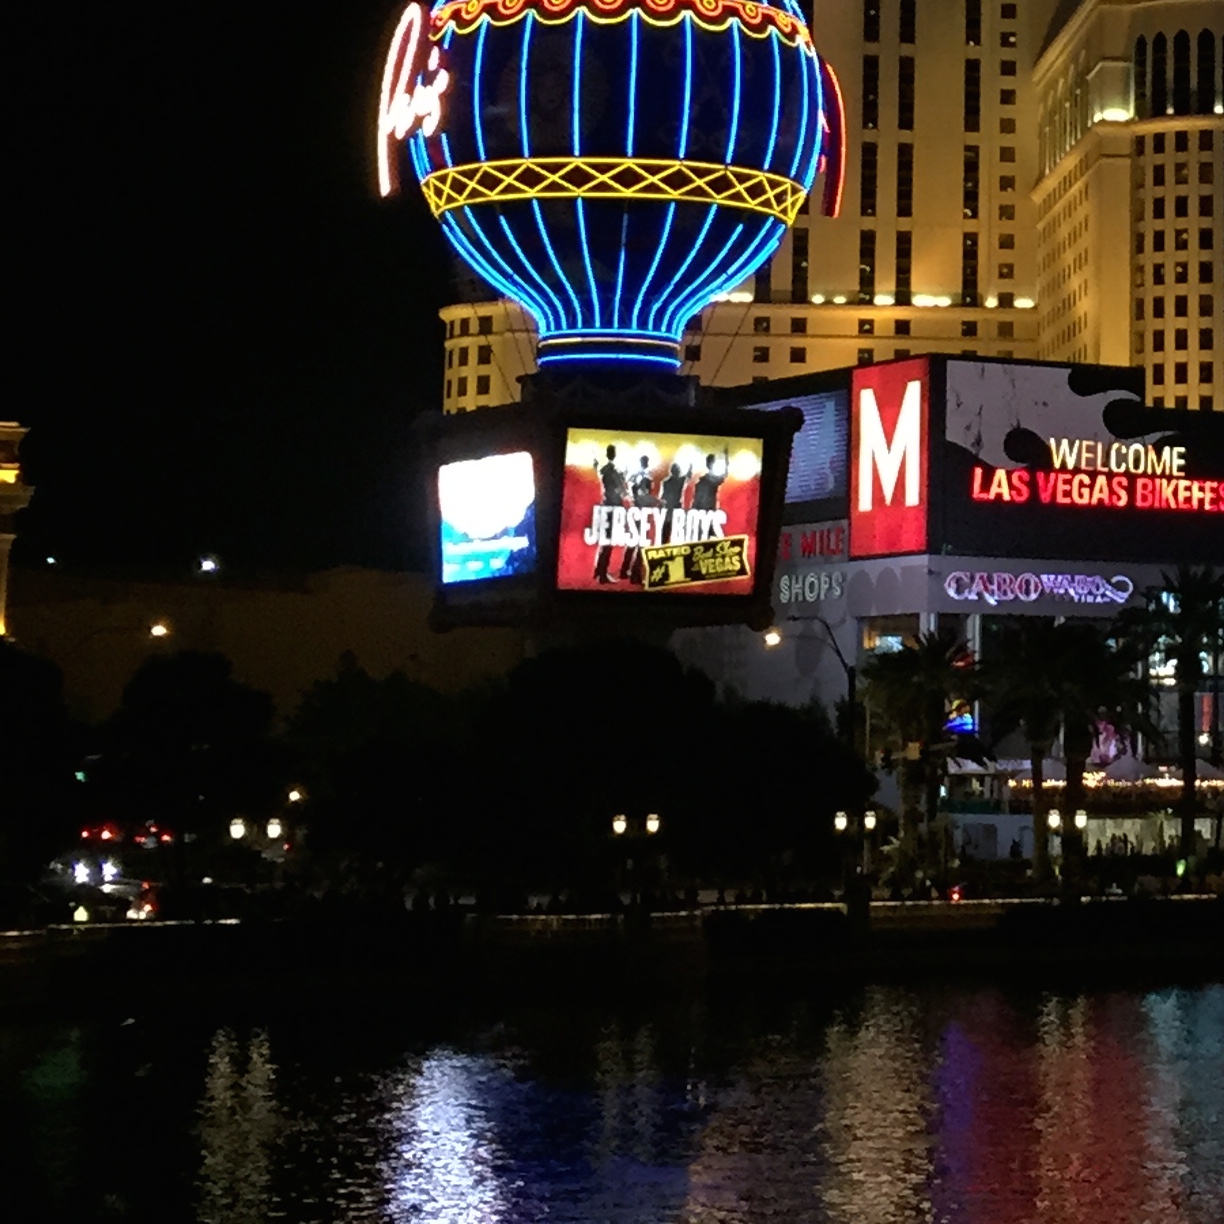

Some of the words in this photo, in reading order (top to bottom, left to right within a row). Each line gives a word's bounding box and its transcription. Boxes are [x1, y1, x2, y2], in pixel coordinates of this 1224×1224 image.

[857, 379, 921, 513] M
[1050, 437, 1186, 475] WELCOME
[972, 467, 1030, 503] LAS
[1037, 472, 1128, 507] VEGAS
[584, 505, 668, 547] JERSEY
[670, 508, 727, 545] BOYS
[801, 527, 845, 559] MILE
[647, 545, 691, 560] RATED
[700, 556, 742, 576] VEGAS
[780, 572, 843, 604] SHOPS
[944, 571, 1042, 606] CABO
